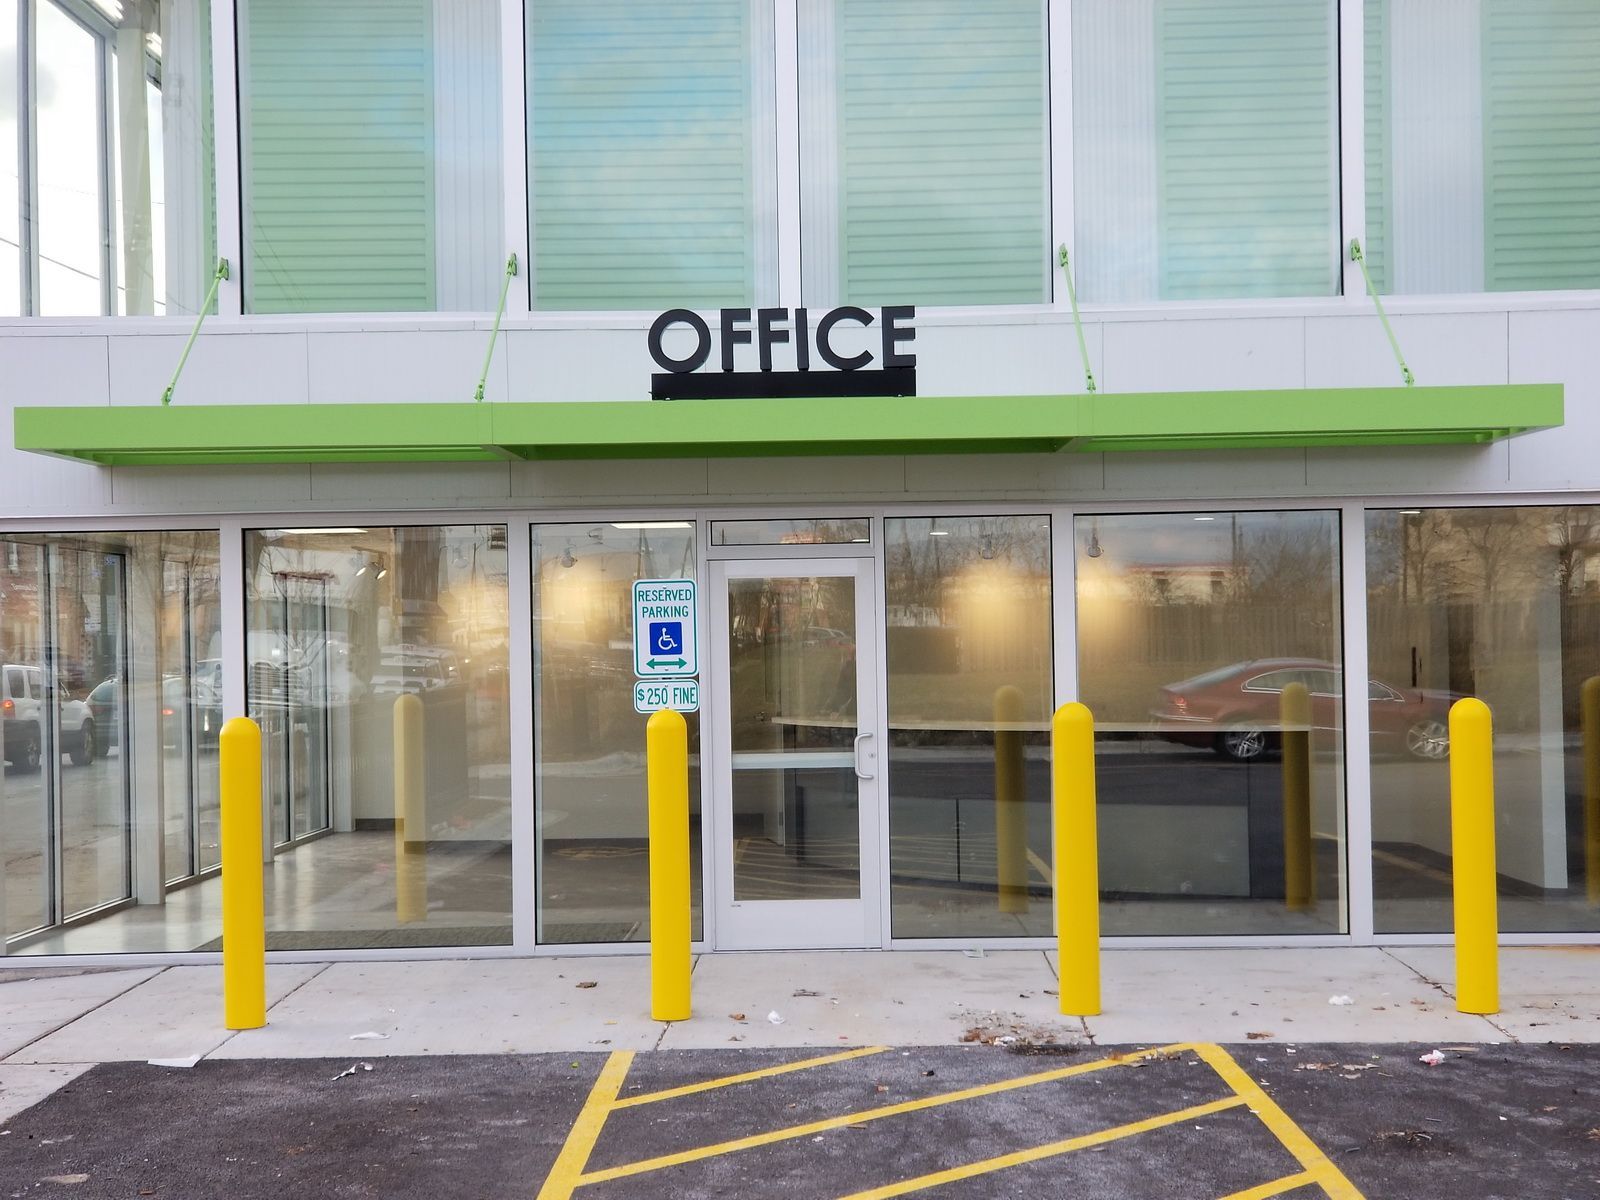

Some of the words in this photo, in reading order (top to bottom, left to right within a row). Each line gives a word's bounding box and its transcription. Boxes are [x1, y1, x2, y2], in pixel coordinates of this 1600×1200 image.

[648, 306, 916, 373] OFFICE
[638, 589, 692, 602] RESERVED
[642, 605, 689, 618] PARKING
[673, 687, 697, 705] FINE
